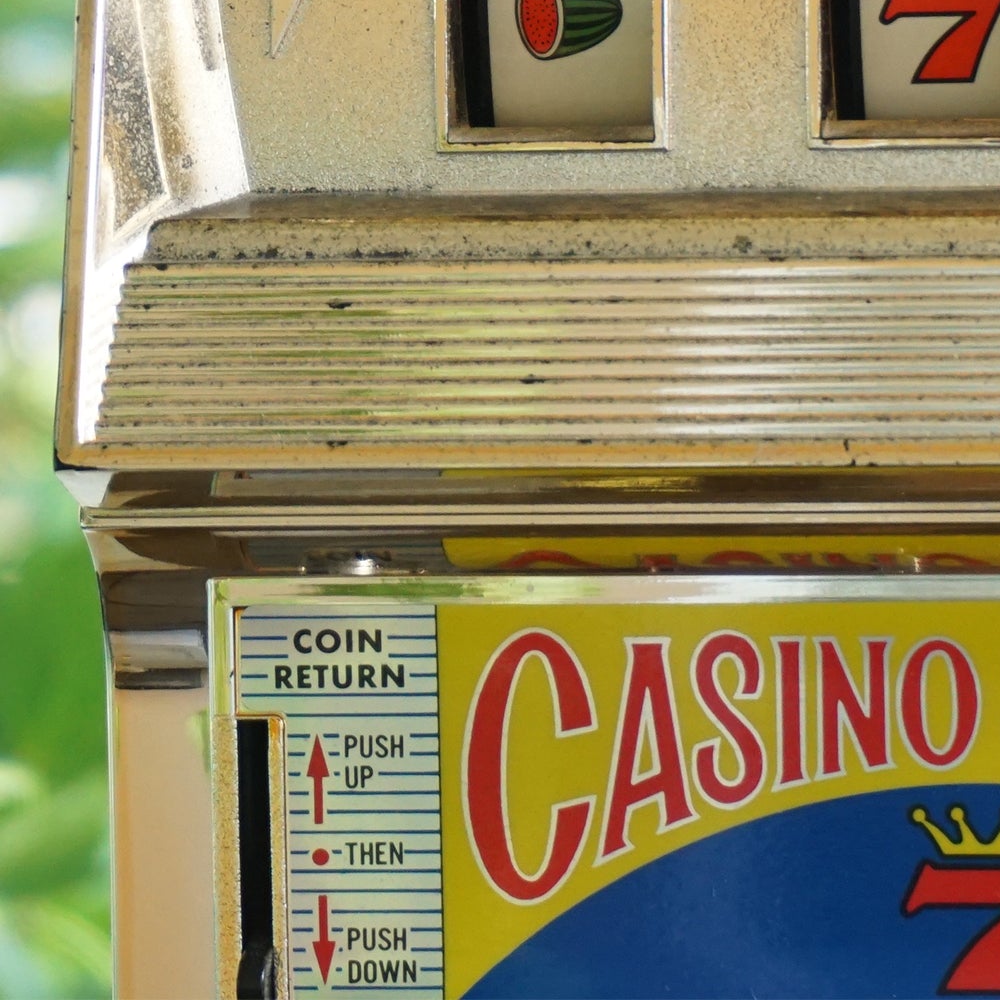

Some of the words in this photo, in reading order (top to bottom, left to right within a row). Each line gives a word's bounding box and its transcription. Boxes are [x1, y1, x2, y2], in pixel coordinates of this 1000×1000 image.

[292, 628, 383, 655] COIN
[274, 663, 406, 690] RETURN
[344, 734, 405, 759] PUSH
[344, 765, 374, 790] UP
[462, 626, 983, 907] CASINO
[345, 841, 404, 866] THEN
[347, 927, 408, 952] PUSH
[347, 959, 418, 985] DOWN
